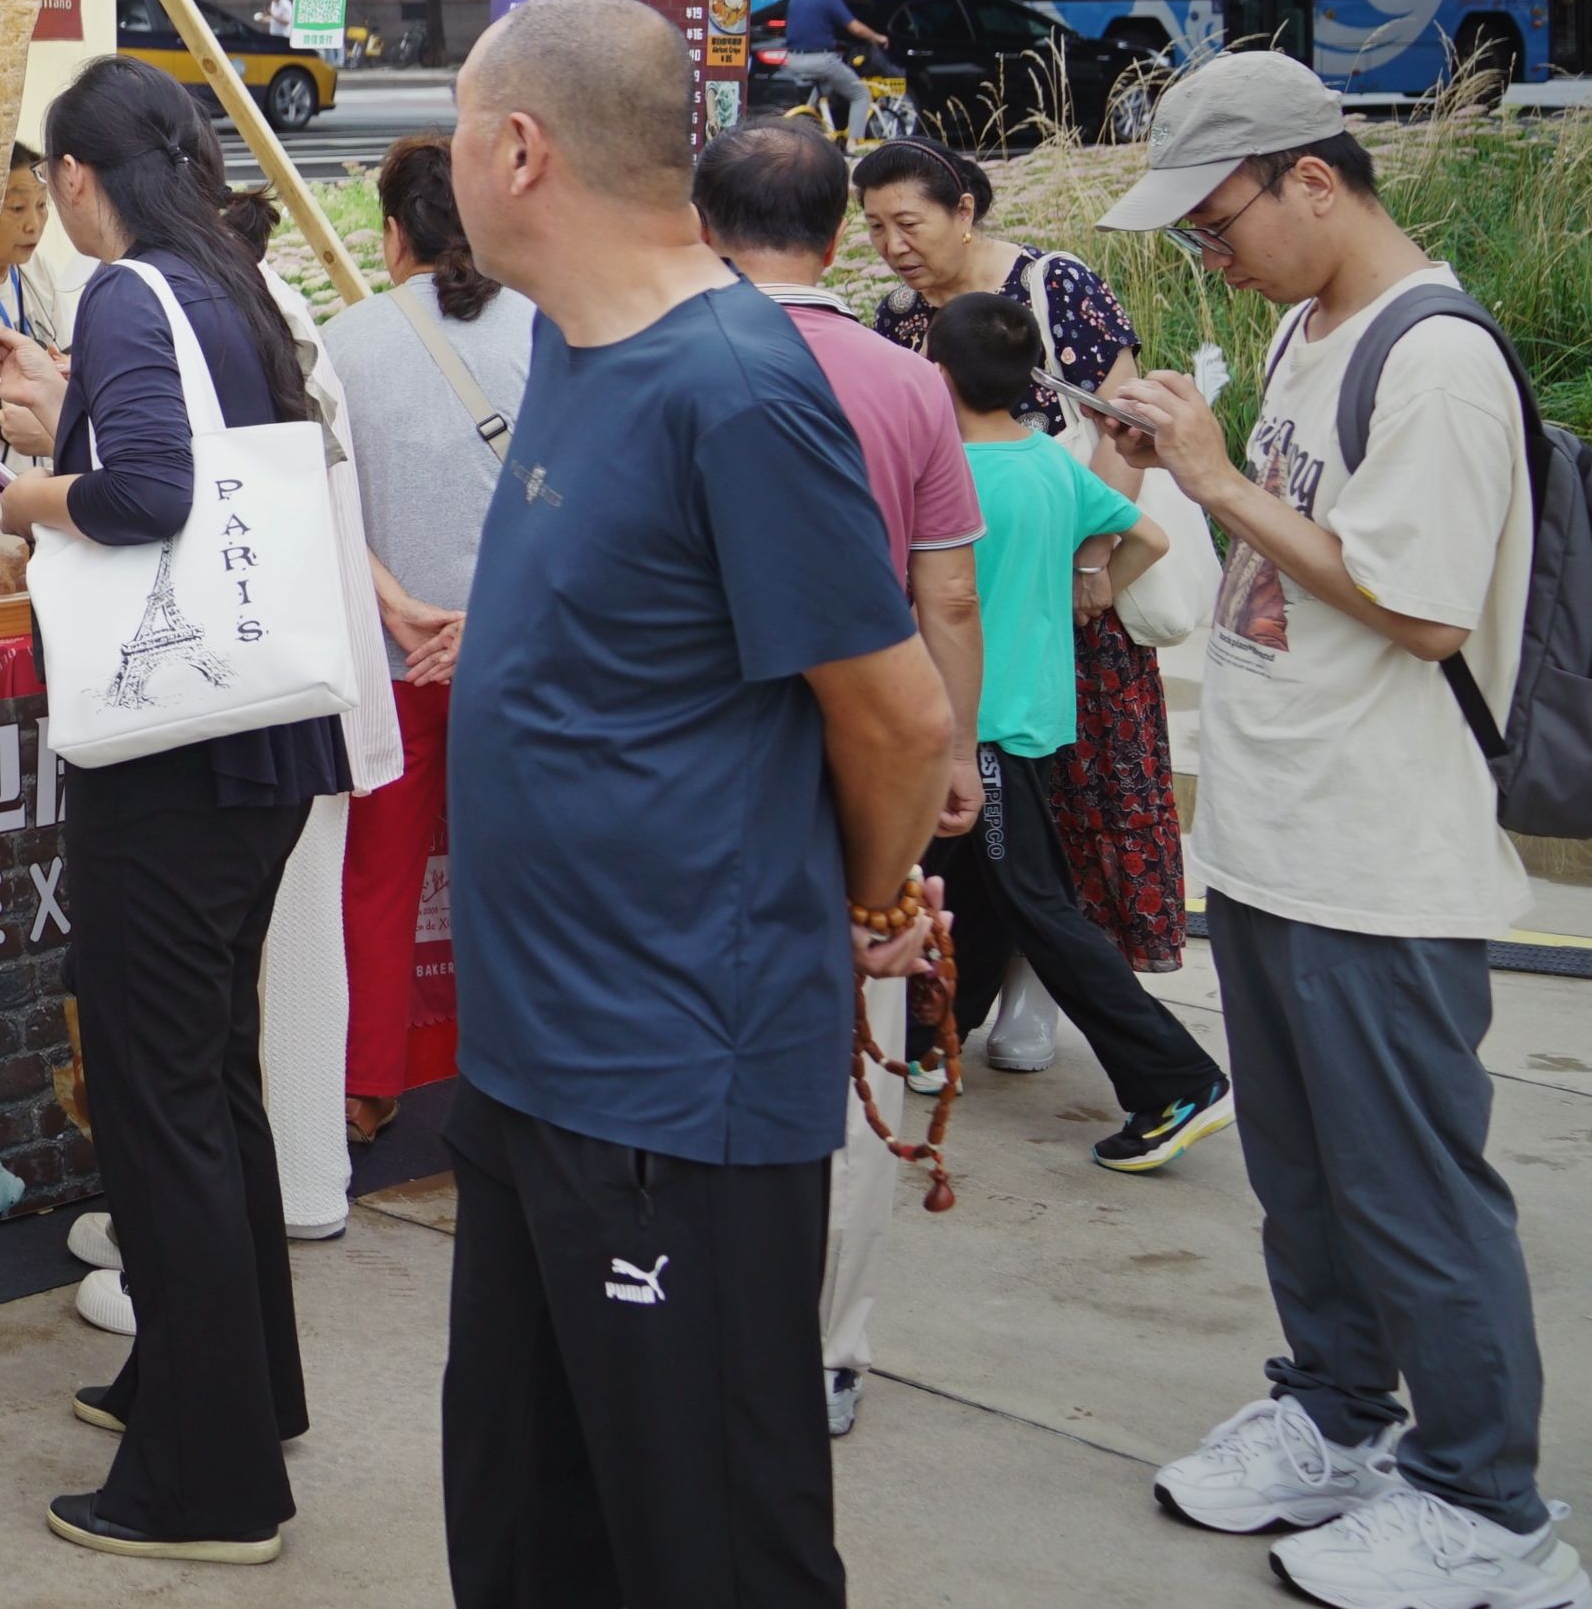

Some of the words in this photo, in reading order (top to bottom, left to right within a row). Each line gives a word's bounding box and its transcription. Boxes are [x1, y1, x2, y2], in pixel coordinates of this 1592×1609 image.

[215, 478, 264, 643] PARIS
[28, 855, 72, 943] X
[416, 961, 456, 978] BAKER
[604, 1281, 657, 1304] PUMA
